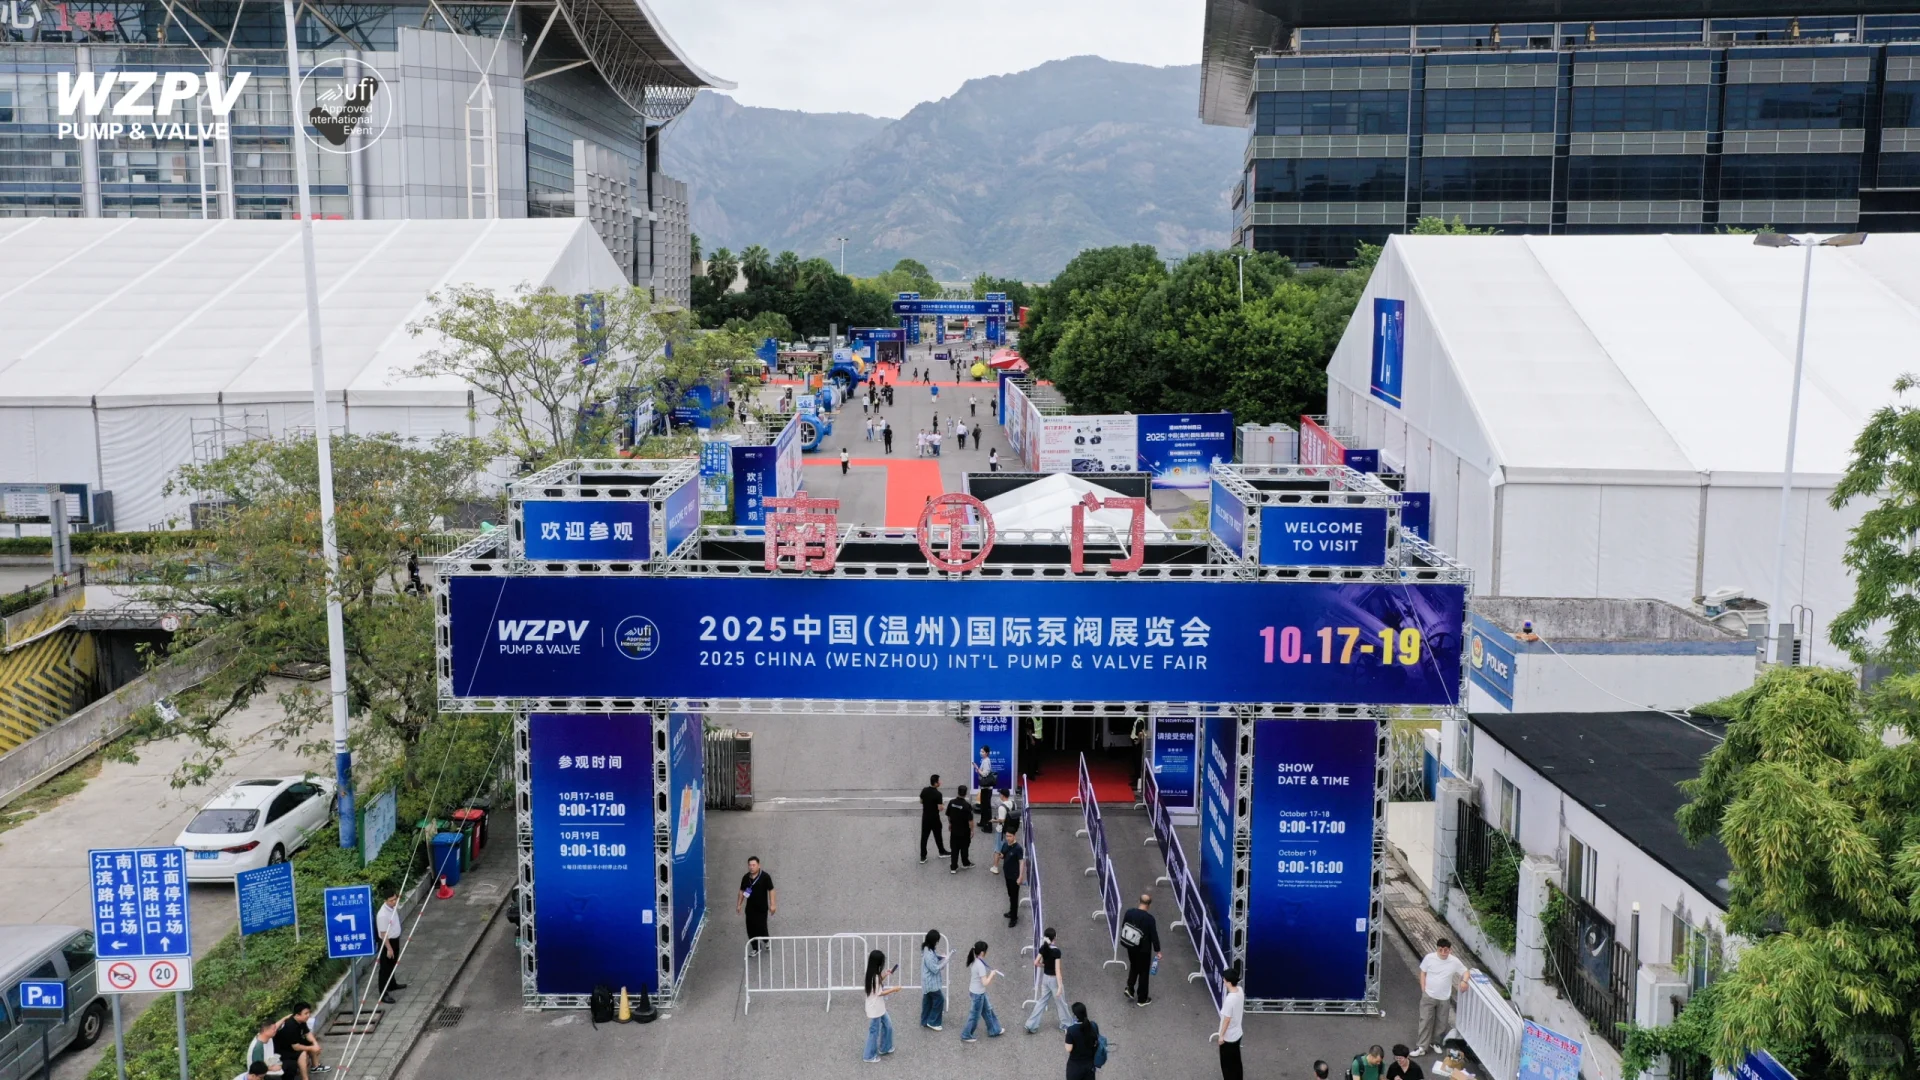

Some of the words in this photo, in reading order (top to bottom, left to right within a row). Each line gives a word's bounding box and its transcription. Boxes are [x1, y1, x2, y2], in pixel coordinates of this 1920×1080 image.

[56, 3, 115, 31] 1号楼
[1146, 433, 1165, 441] 2025
[747, 472, 758, 521] 欢迎参观
[541, 521, 634, 541] 欢迎参观
[1285, 522, 1363, 534] WELCOME
[1293, 540, 1313, 551] TO
[1319, 540, 1359, 551] VISIT
[498, 620, 590, 641] WZPV
[637, 625, 652, 636] ufi
[699, 614, 1212, 648] 2025中国(温州)国际泵阀展览会
[500, 645, 532, 654] PUMP
[535, 645, 544, 654] &
[546, 645, 581, 654] VALVE
[1260, 626, 1421, 665] 10.17-19
[700, 651, 745, 666] 2025
[755, 651, 817, 667] CHINA
[826, 651, 939, 671] (WENZHOU)
[949, 654, 998, 669] INT'L
[1008, 654, 1062, 669] PUMP
[1071, 655, 1083, 669] &
[1092, 655, 1154, 669] VALVE
[1164, 655, 1207, 670] FAIR
[1486, 653, 1508, 679] POLICE
[1157, 732, 1194, 740] 请接受安检
[558, 755, 622, 769] 参观时间
[1278, 763, 1314, 772] SHOW
[1278, 776, 1307, 785] DATE
[1310, 776, 1319, 785] &
[1321, 776, 1350, 785] TIME
[559, 791, 614, 801] 10月17-18日
[559, 803, 625, 816] 9:00-17:00
[1309, 810, 1330, 818] 17-18
[1279, 820, 1346, 834] 9:00-17:00
[560, 831, 599, 840] 10月19日
[560, 844, 626, 857] 9:00-16:00
[1278, 849, 1306, 857] October
[1278, 860, 1344, 874] 9:00-16:00
[95, 855, 116, 935] 江滨路出口
[115, 854, 138, 935] 南1停车场
[140, 853, 161, 934] 瓯江路出口
[162, 853, 183, 934] 北面停车场
[332, 899, 364, 907] GALLERIA
[156, 968, 171, 979] 20
[27, 986, 43, 1005] P
